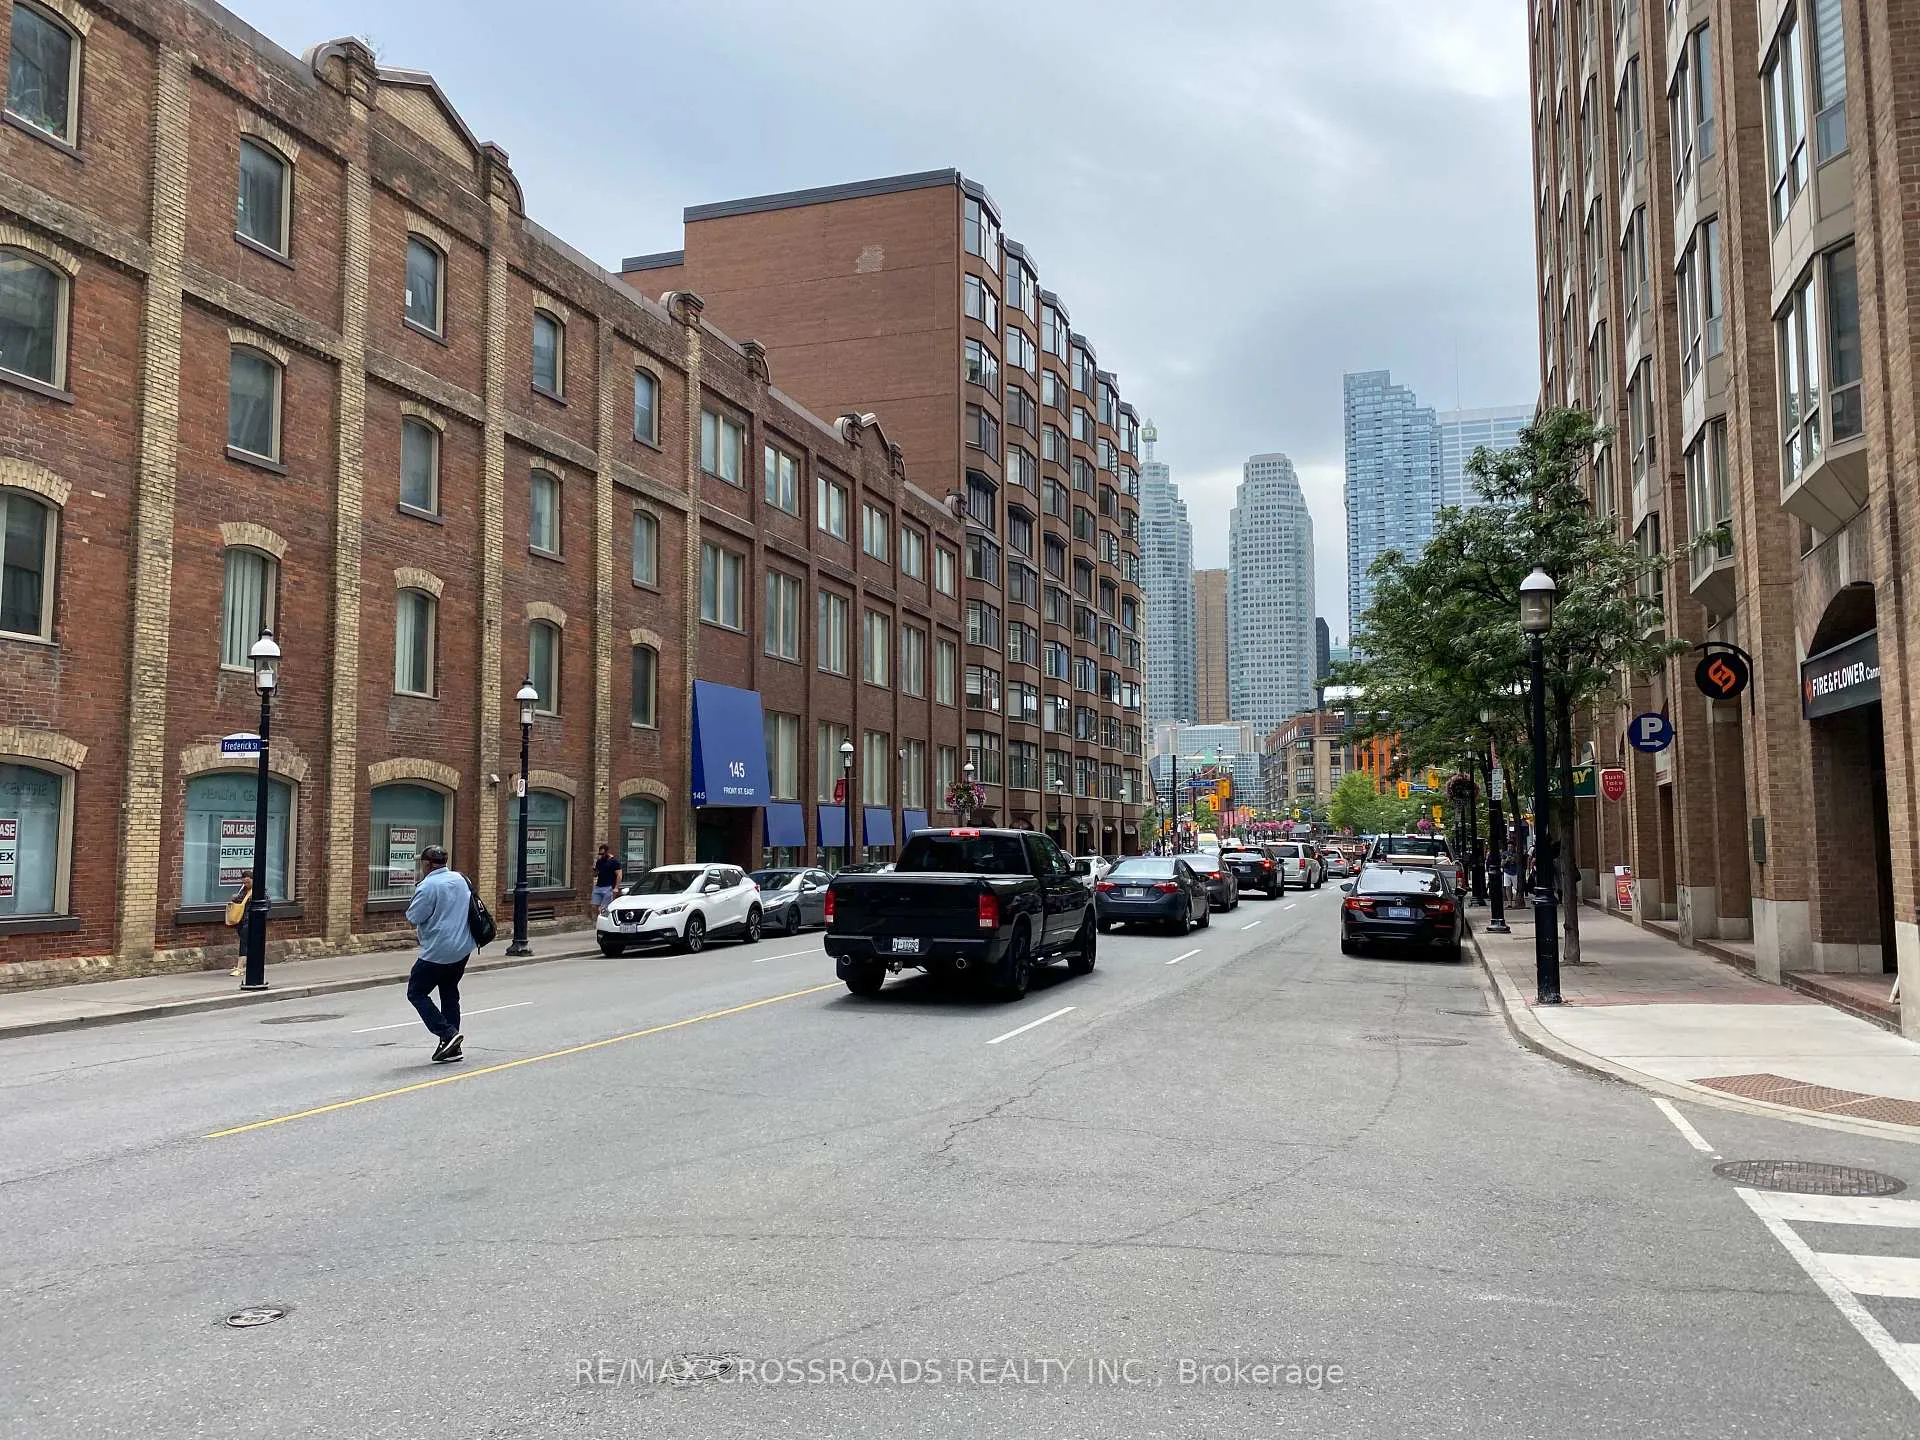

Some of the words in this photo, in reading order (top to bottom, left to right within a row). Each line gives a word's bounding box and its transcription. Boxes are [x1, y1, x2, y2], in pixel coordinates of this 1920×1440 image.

[1640, 717, 1663, 740] P
[224, 741, 252, 751] Frederick
[729, 761, 745, 778] 145
[692, 791, 706, 800] 145
[723, 786, 737, 795] FRONT
[744, 787, 755, 796] EAST
[222, 824, 236, 835] FOR
[236, 824, 255, 835] LEASE
[401, 832, 416, 842] LEASE
[221, 847, 255, 856] RENTEX
[390, 852, 415, 860] RENTEX
